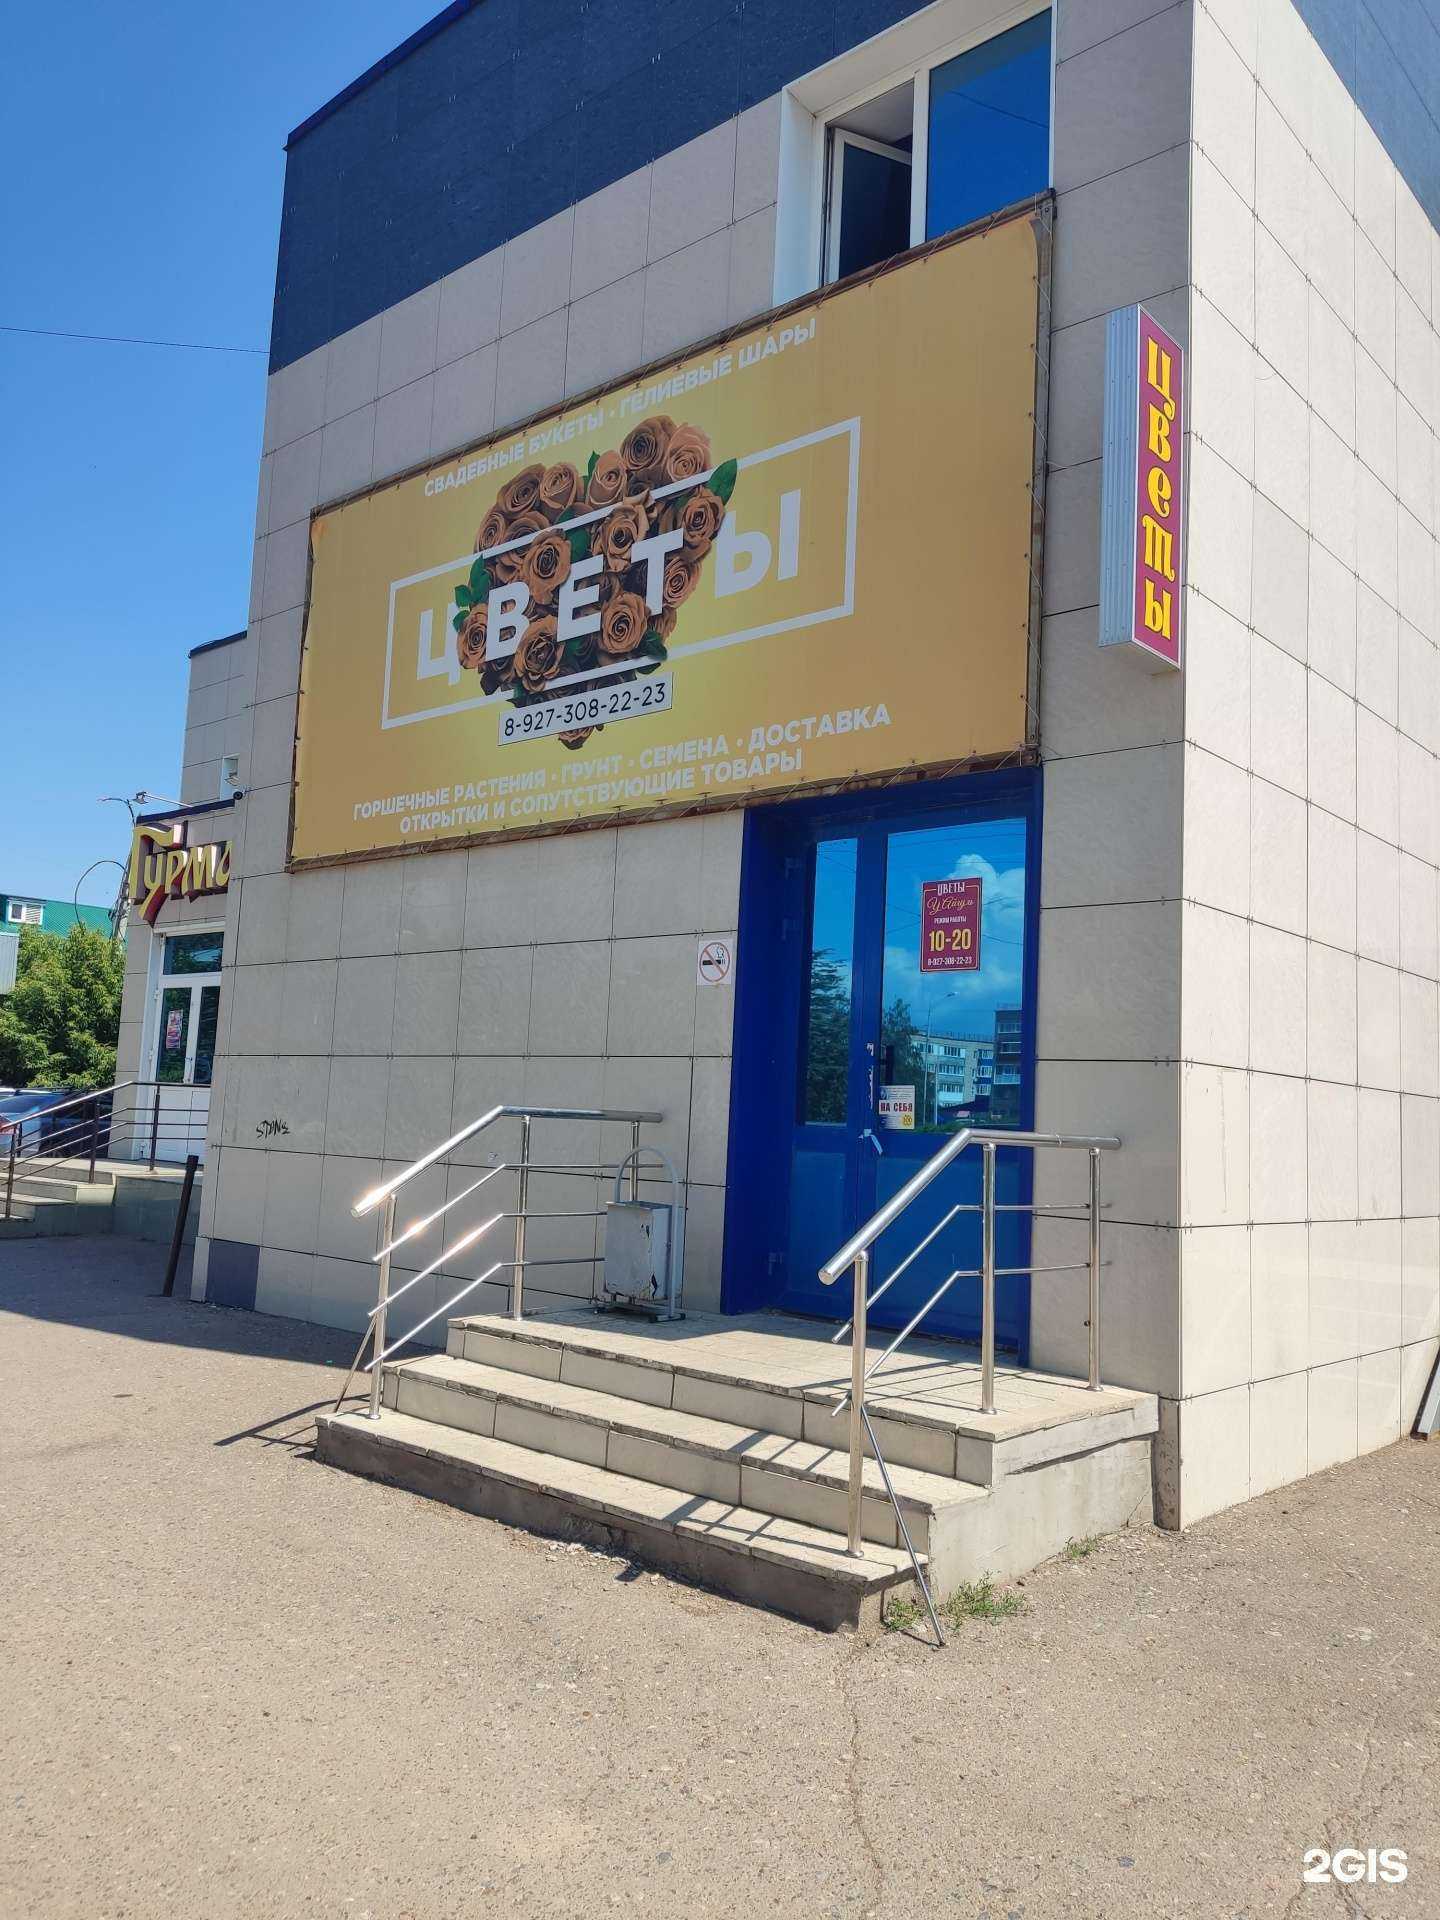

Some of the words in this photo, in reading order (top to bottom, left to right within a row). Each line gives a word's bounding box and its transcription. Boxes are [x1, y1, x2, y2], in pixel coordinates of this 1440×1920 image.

[423, 441, 525, 497] СВАДЕБНЫЕ
[528, 408, 604, 456] БУКЕТЫ
[619, 354, 732, 418] ГЕЛИЕВЫЕ
[738, 317, 816, 369] ШАРЫ
[416, 488, 801, 686] ЦВЕТЫ
[504, 682, 666, 737] 8-927-308-22-23
[353, 786, 450, 820] ГОРШЕЧНЫЕ
[454, 768, 546, 804] РАСТЕНИЯ
[561, 755, 623, 784] ГРУНТ
[639, 733, 731, 769] СЕМЕНА
[748, 703, 892, 754] ДОСТАВКА
[399, 802, 490, 834] ОТКРЫТКИ
[493, 802, 505, 820] И
[510, 767, 696, 818] СОПУТСТВУЮЩИЕ
[701, 749, 802, 786] ТОВАРЫ
[937, 882, 965, 897] ЦВЕТЫ
[928, 928, 973, 952] 10-20
[880, 1102, 891, 1112] НА
[893, 1102, 913, 1113] СЕБЯ
